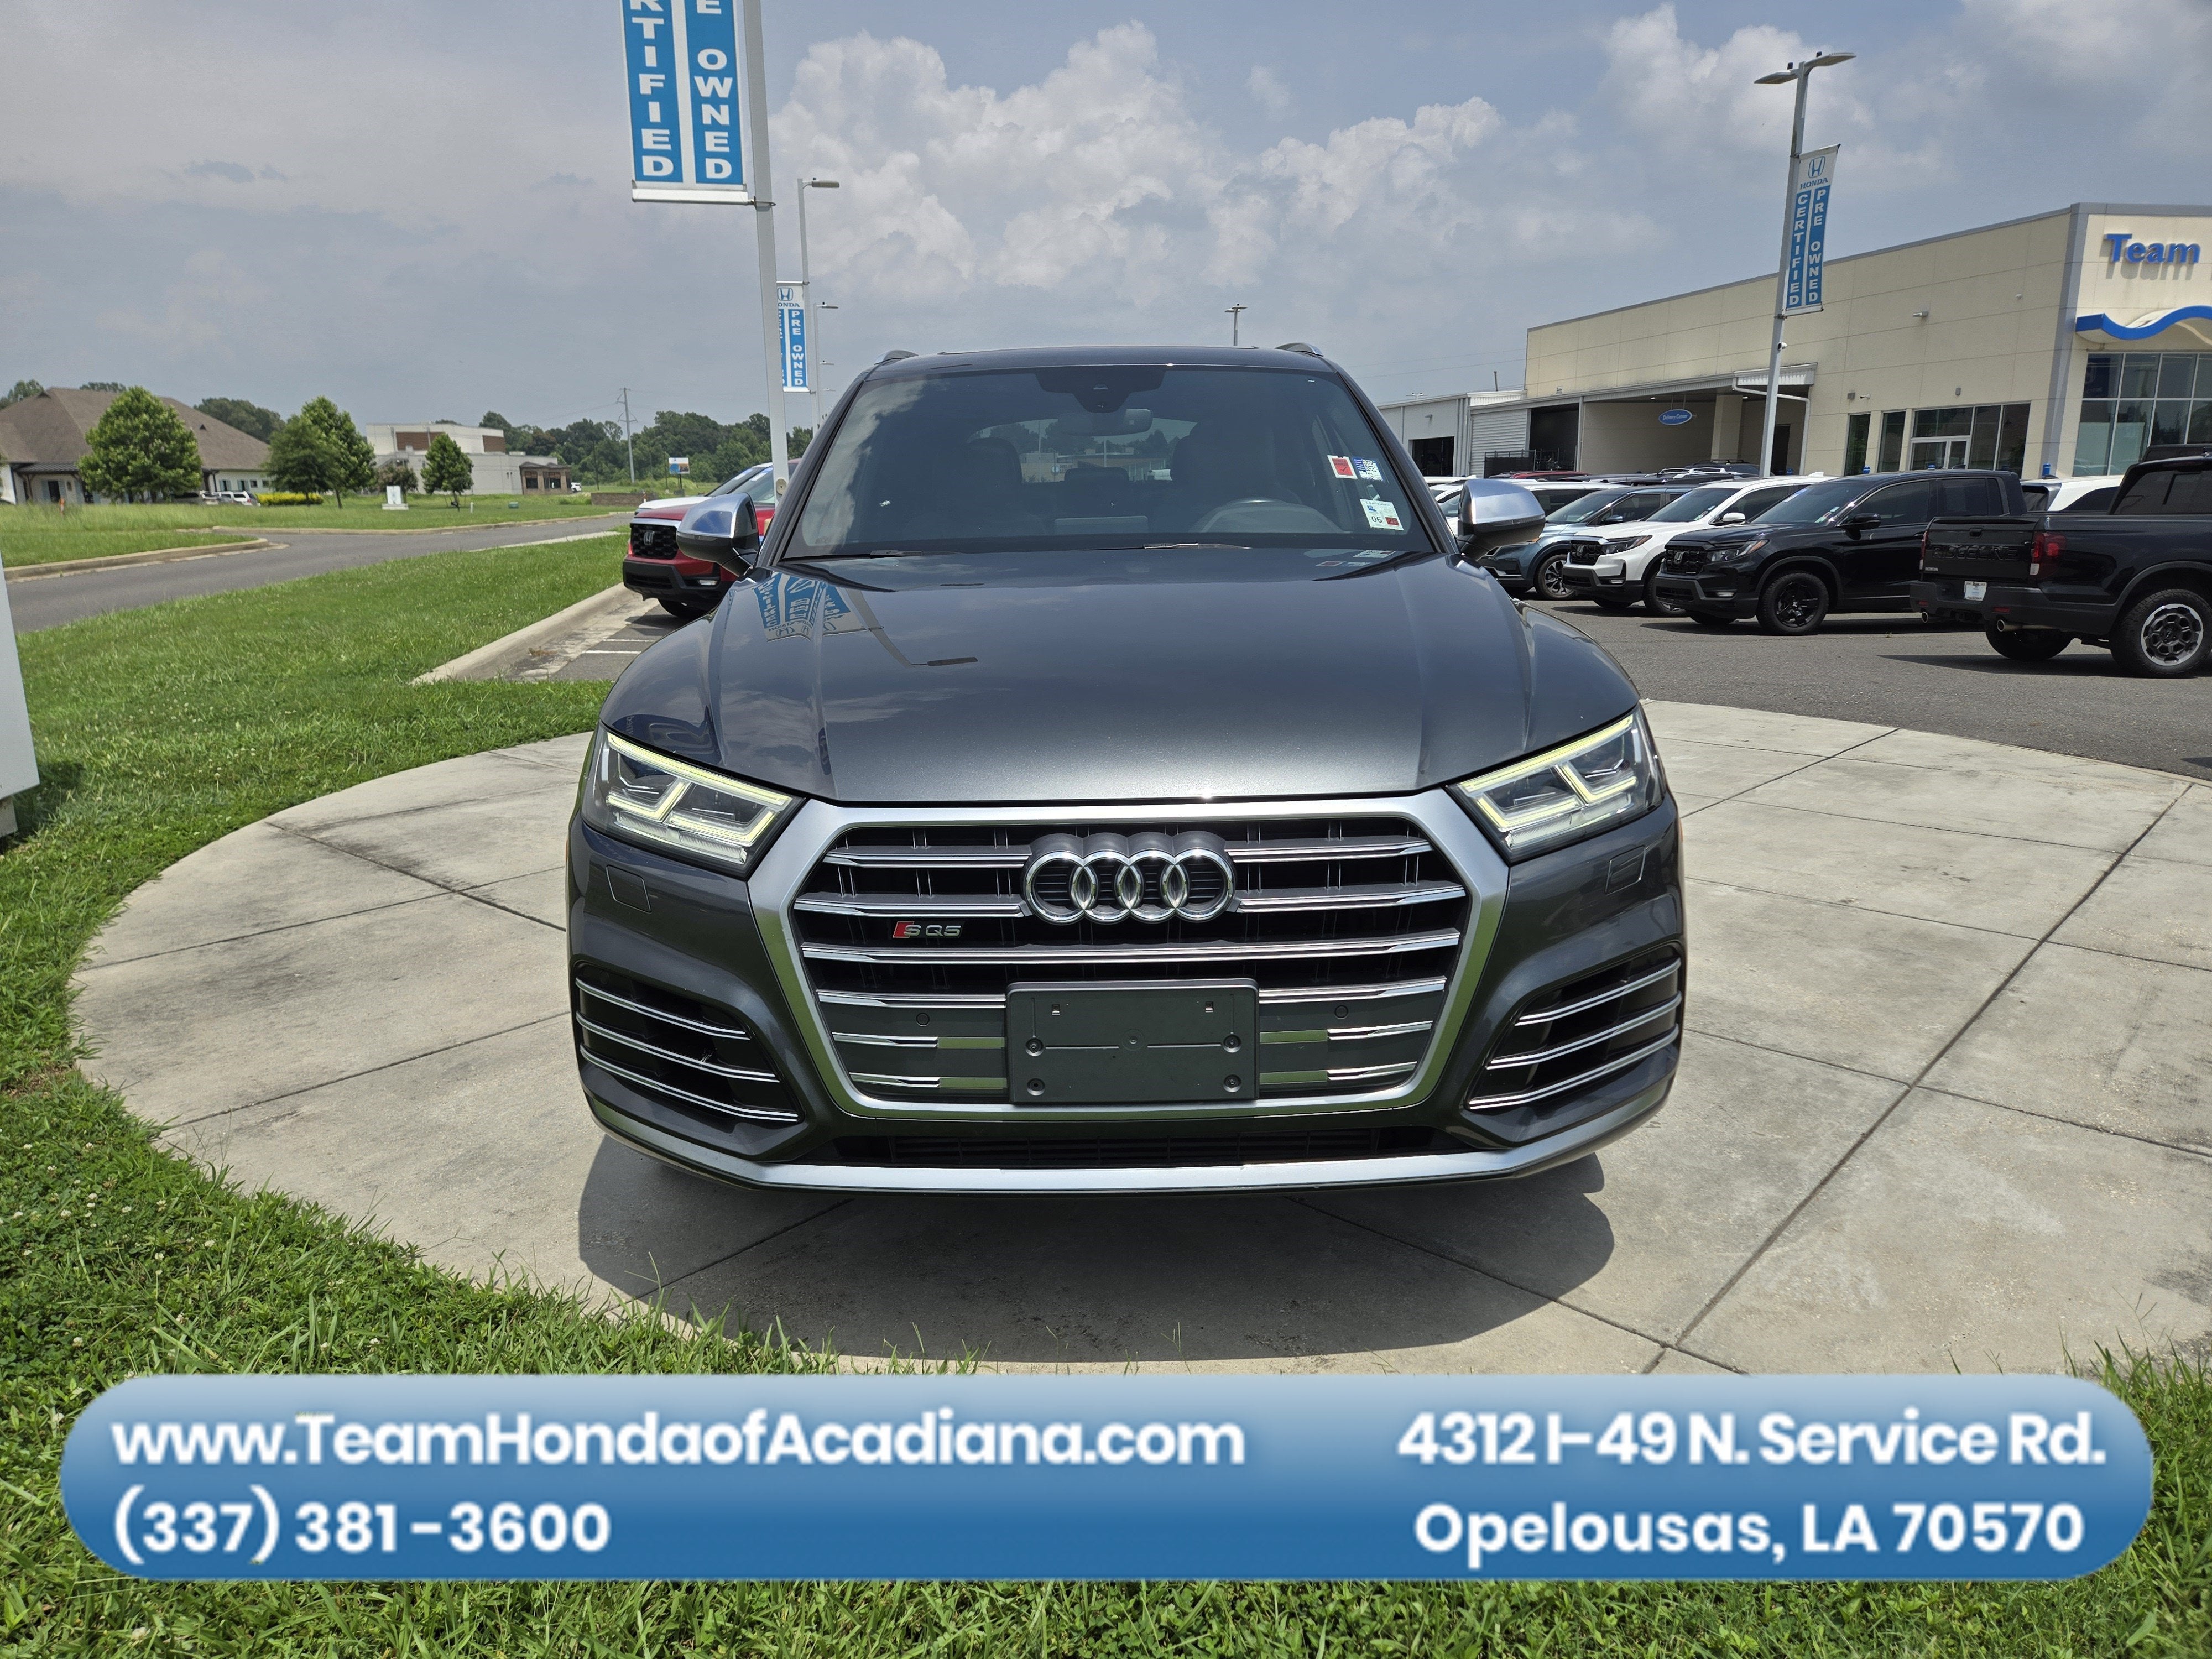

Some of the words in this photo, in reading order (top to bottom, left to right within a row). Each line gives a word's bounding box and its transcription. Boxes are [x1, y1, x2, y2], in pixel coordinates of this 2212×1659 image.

[694, 49, 732, 179] OWNED
[1800, 178, 1828, 190] HONDA
[1813, 189, 1826, 226] PRE
[1789, 194, 1808, 305] CERTIFIED
[2105, 233, 2201, 264] Team
[1808, 241, 1822, 302] OWNED
[791, 311, 801, 335] PRE
[791, 345, 804, 386] OWNED
[904, 925, 961, 936] SQ5
